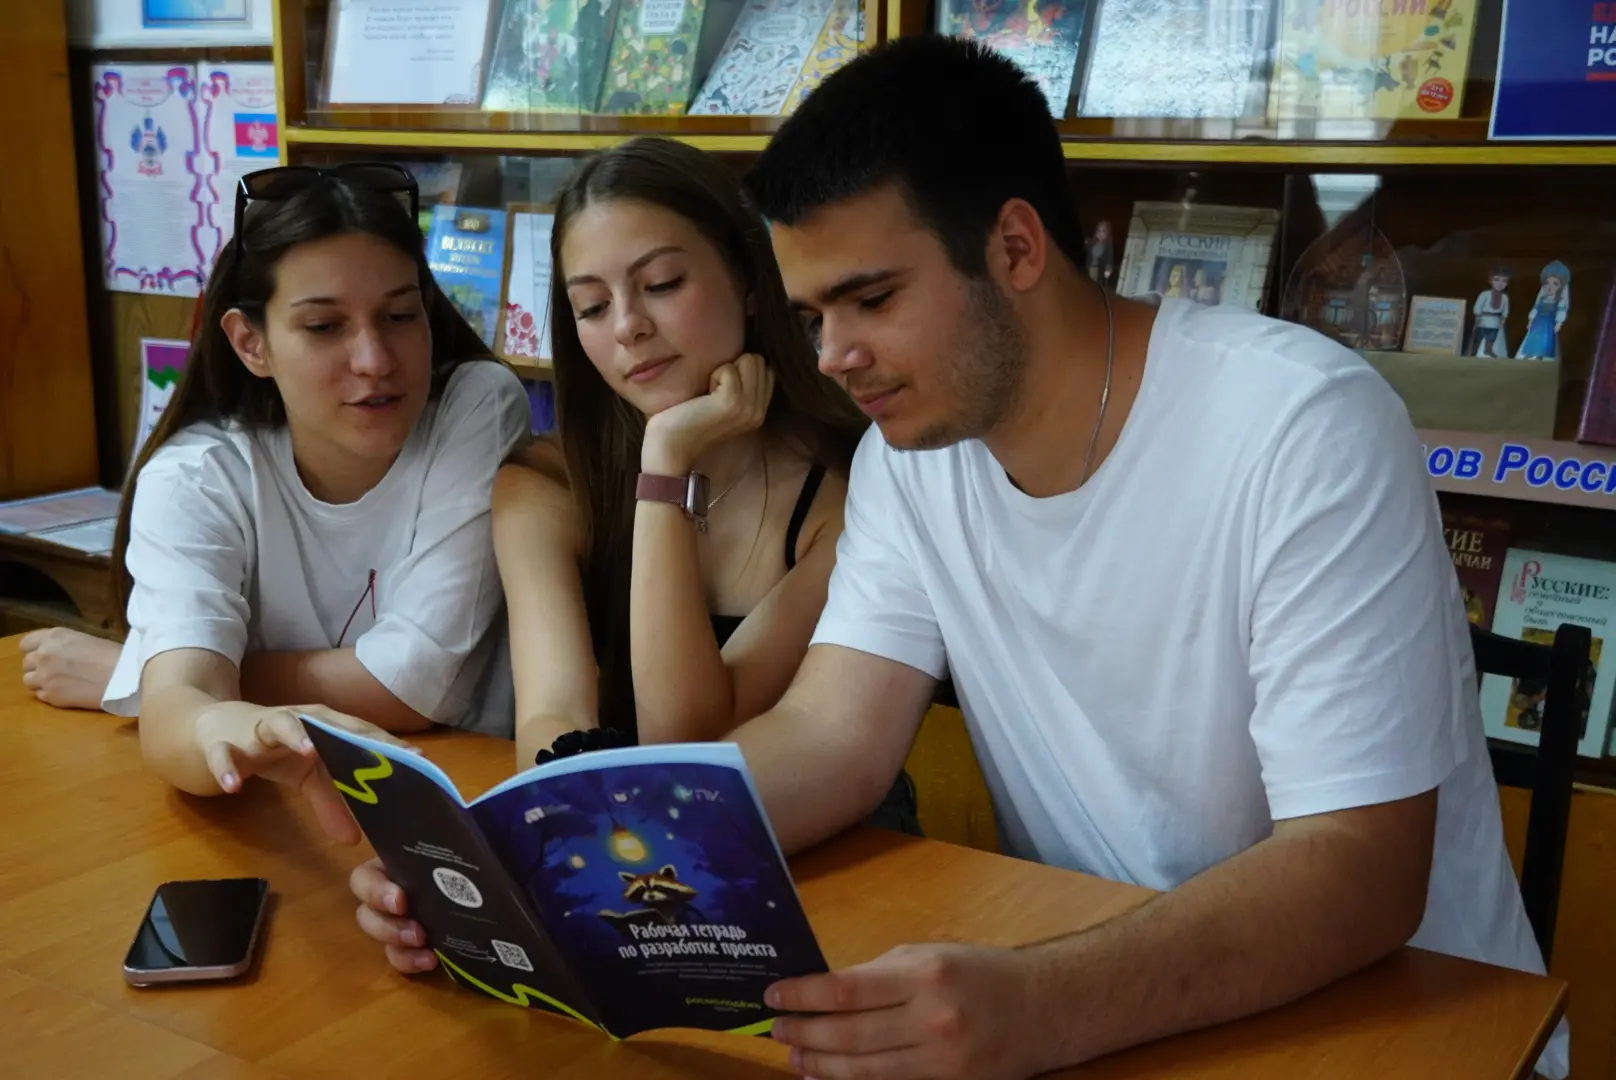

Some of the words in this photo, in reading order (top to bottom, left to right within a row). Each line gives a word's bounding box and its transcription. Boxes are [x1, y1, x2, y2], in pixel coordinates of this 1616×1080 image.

[1421, 444, 1483, 479] ов
[628, 921, 690, 940] Рабочая
[690, 923, 747, 941] тетрадь
[617, 945, 638, 960] по
[638, 938, 720, 960] разработке
[720, 942, 778, 960] проекта
